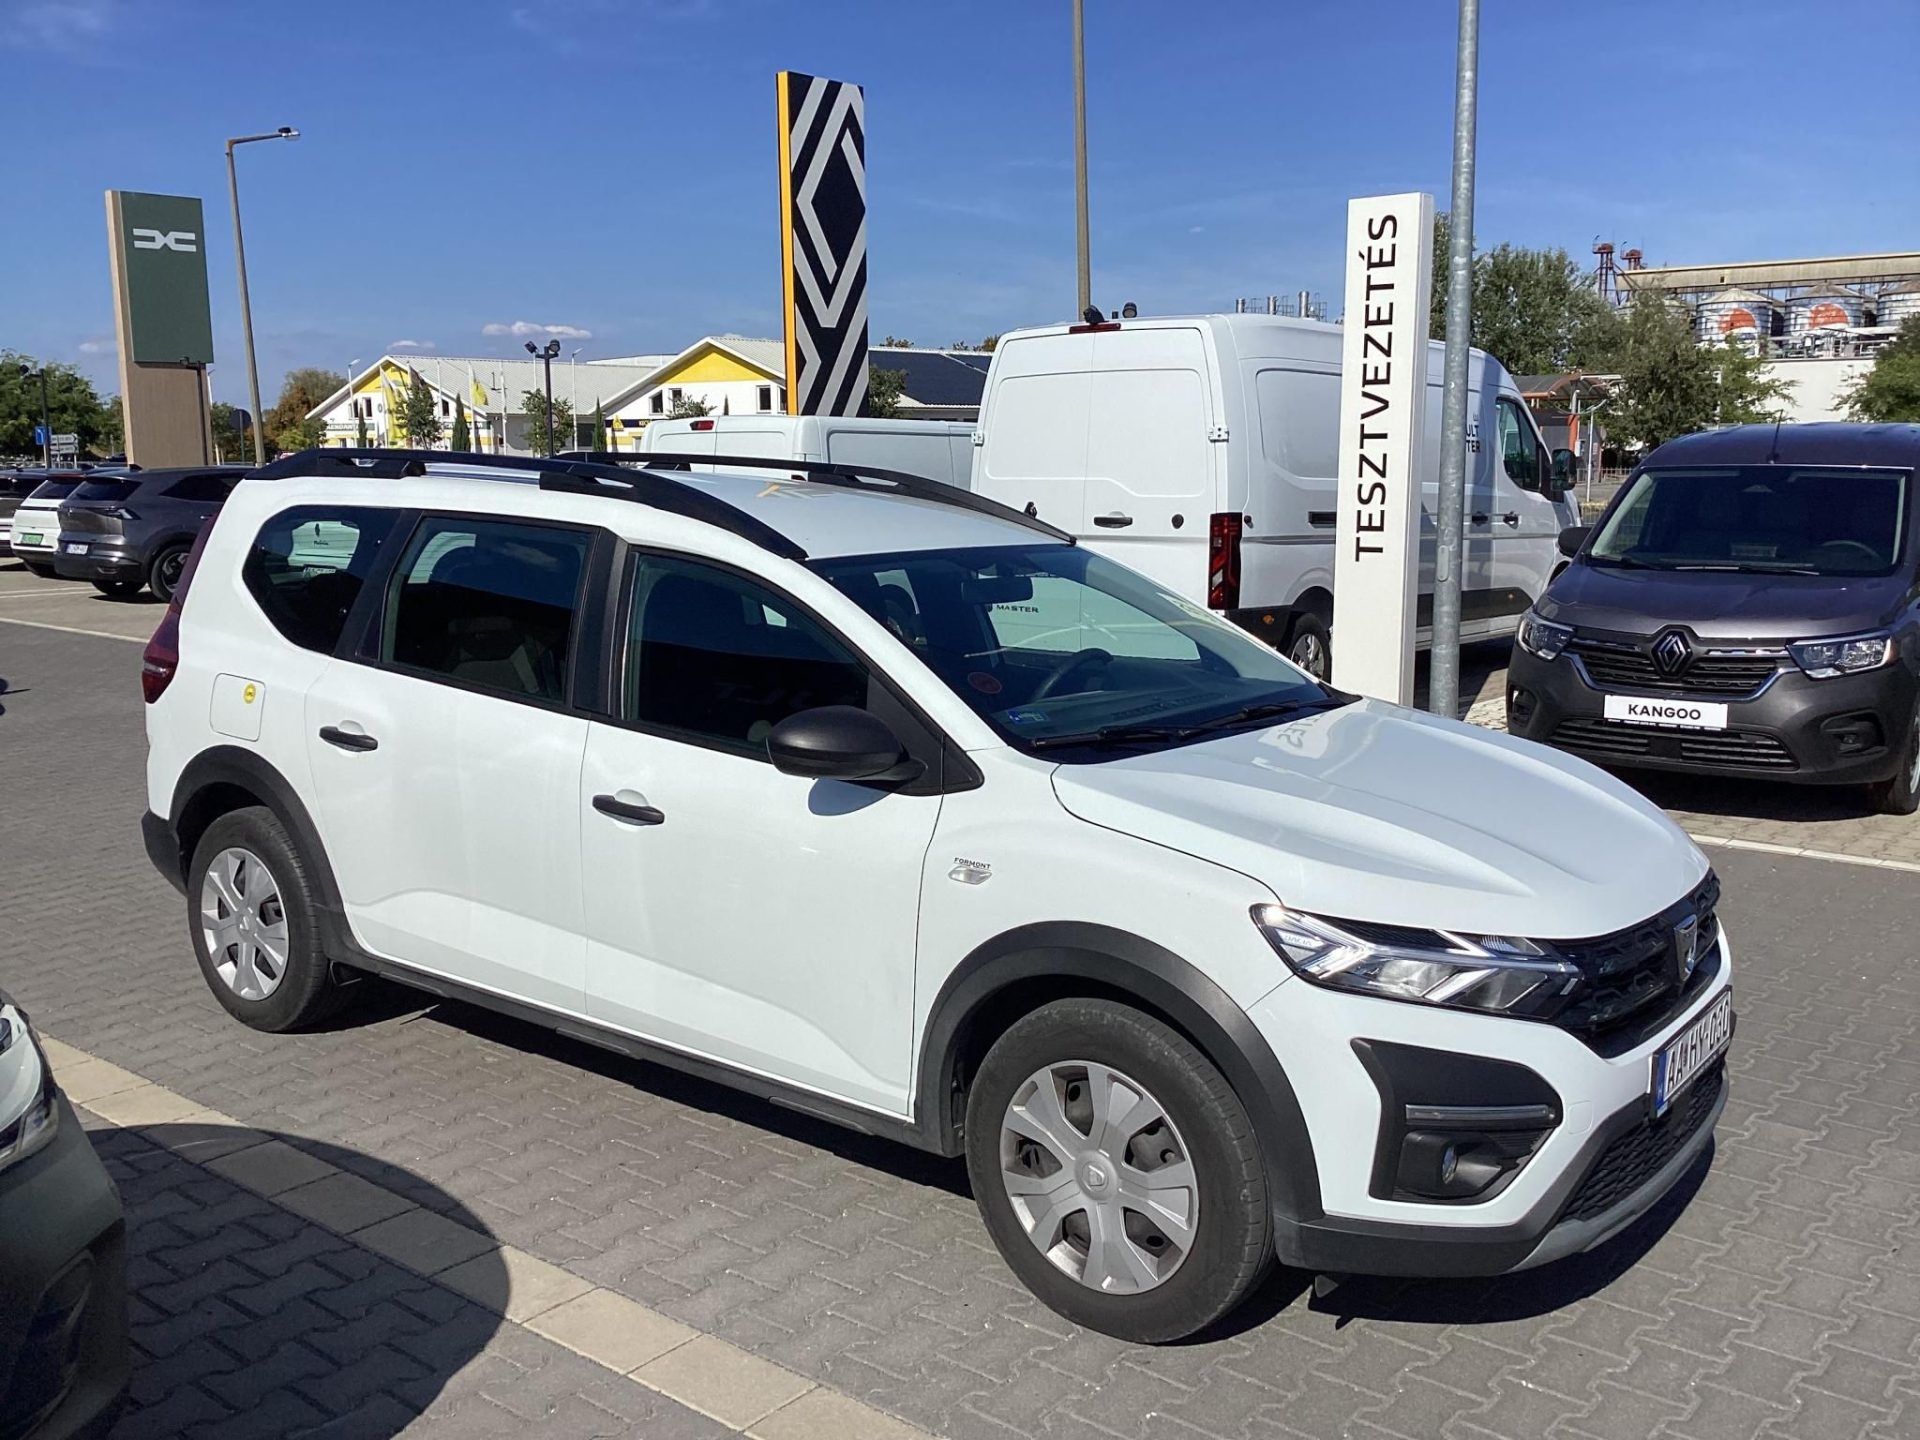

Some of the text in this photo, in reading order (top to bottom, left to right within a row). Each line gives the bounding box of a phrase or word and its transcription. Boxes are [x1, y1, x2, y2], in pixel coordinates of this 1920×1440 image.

[1354, 214, 1398, 562] TESZTVEZETÉS
[996, 604, 1040, 614] MASTER
[1628, 703, 1702, 720] KANGOO
[953, 857, 991, 869] FORMONT
[1667, 1041, 1684, 1092] AA
